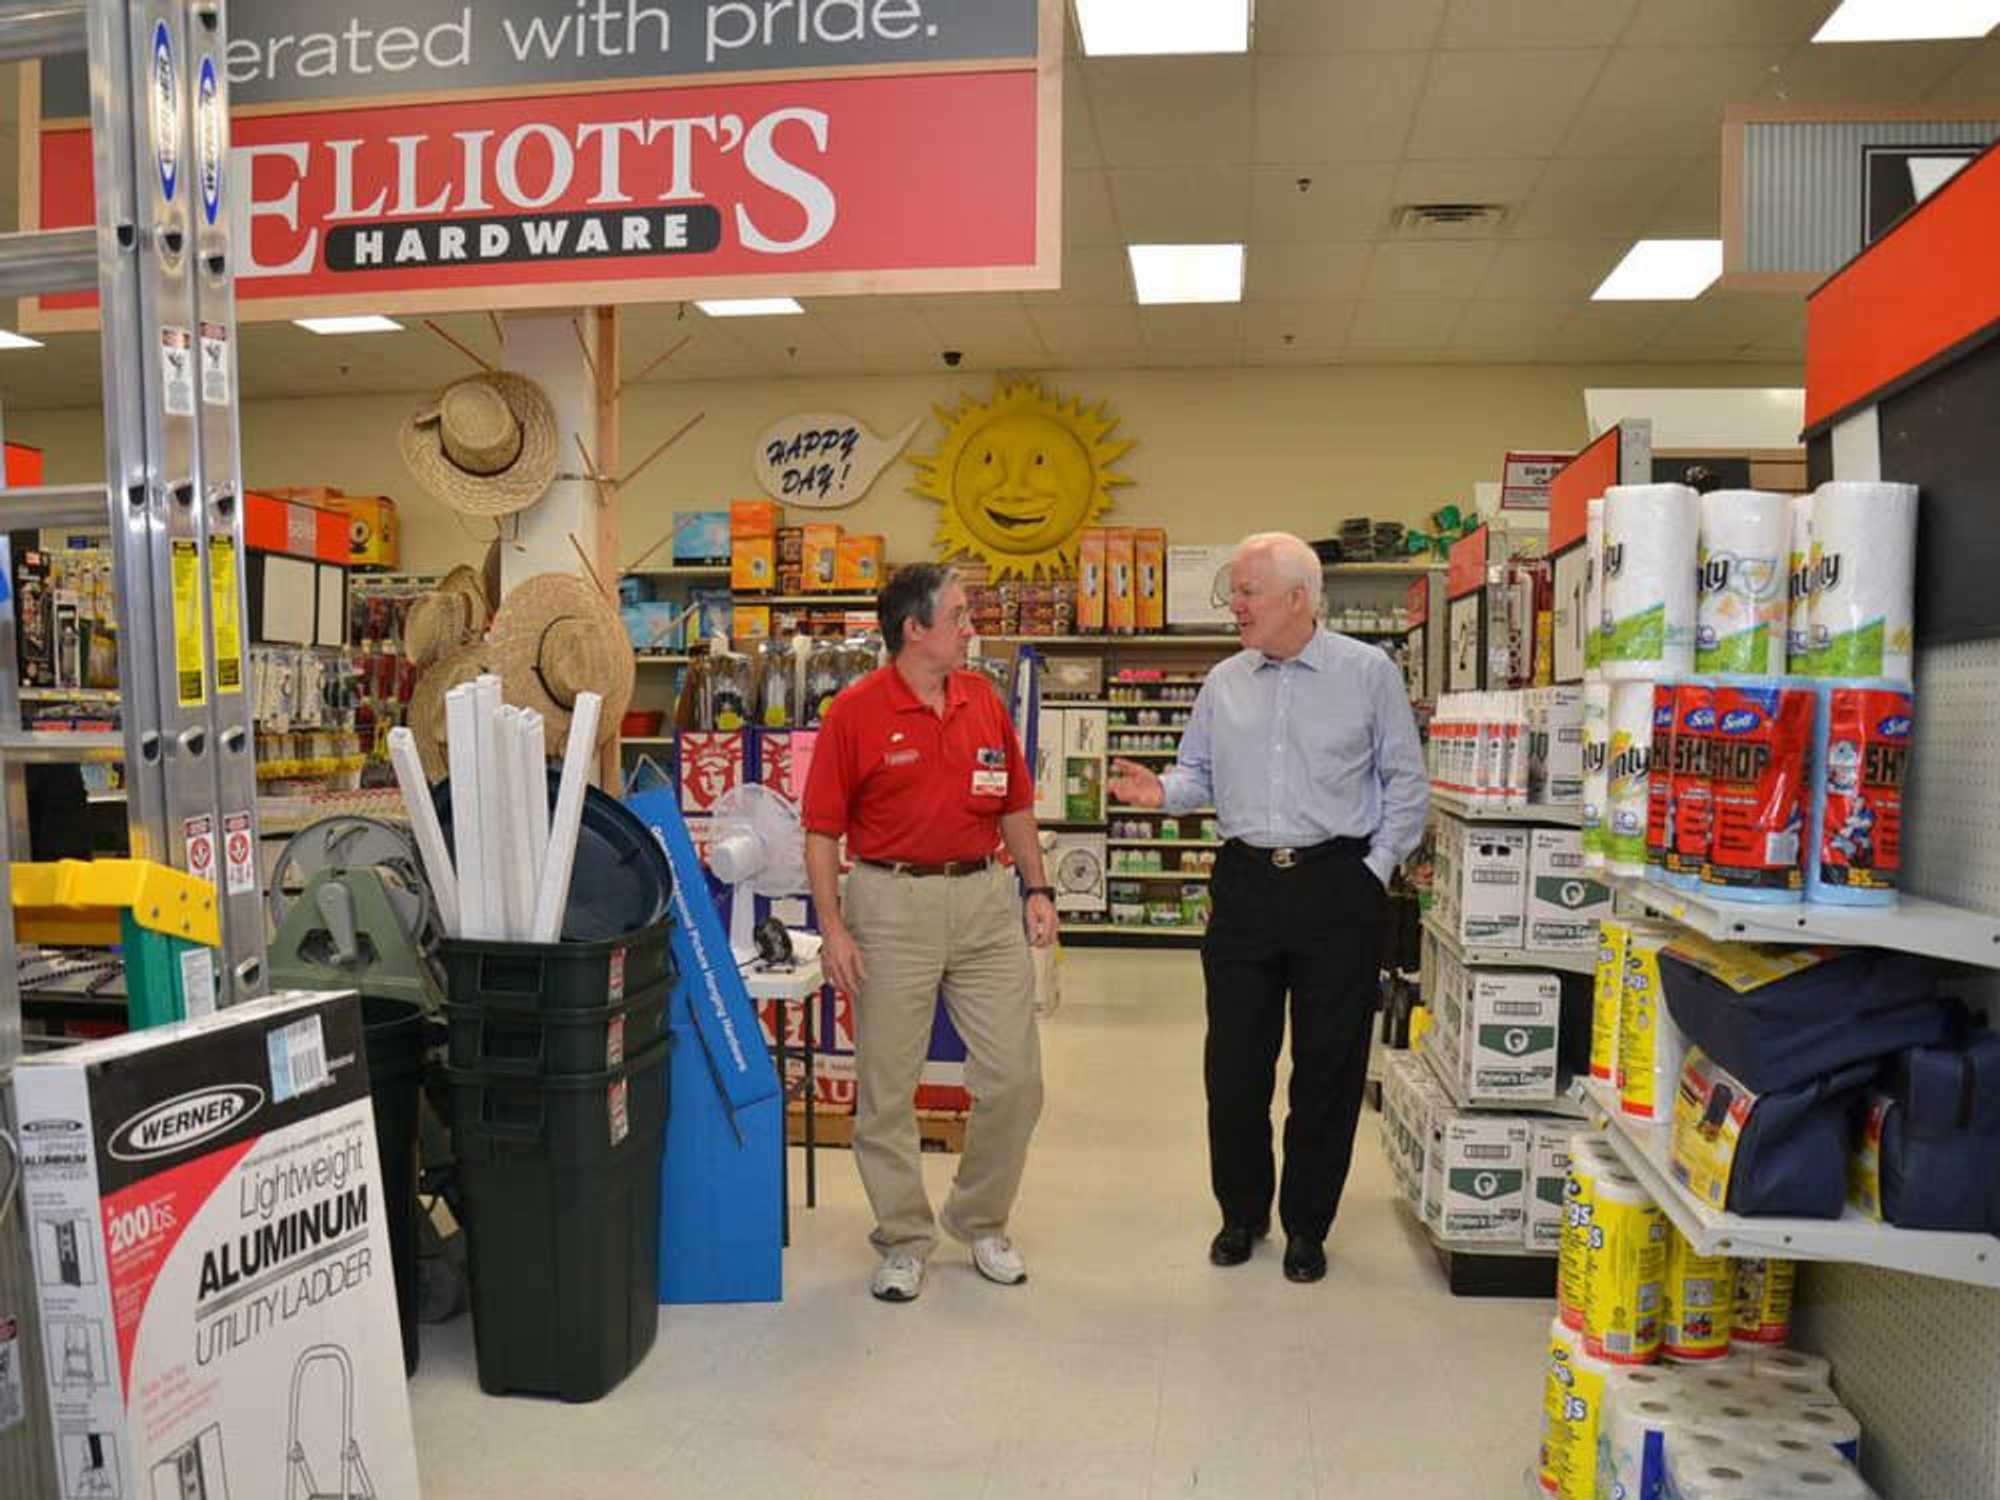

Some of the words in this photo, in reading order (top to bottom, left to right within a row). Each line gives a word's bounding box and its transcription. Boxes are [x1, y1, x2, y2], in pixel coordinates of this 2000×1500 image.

[502, 0, 669, 62] with
[705, 0, 939, 62] pride.
[232, 107, 837, 278] ELLIOTT'S
[353, 214, 689, 265] HARDWARE
[765, 426, 861, 467] HAPPY
[781, 463, 851, 499] DAY!
[141, 1097, 234, 1147] WERNER
[240, 1136, 365, 1220] Lightweight
[109, 1204, 150, 1253] 200
[198, 1183, 368, 1301] ALUMINUM
[196, 1288, 282, 1367] UTILITY
[282, 1247, 372, 1320] LADDER
